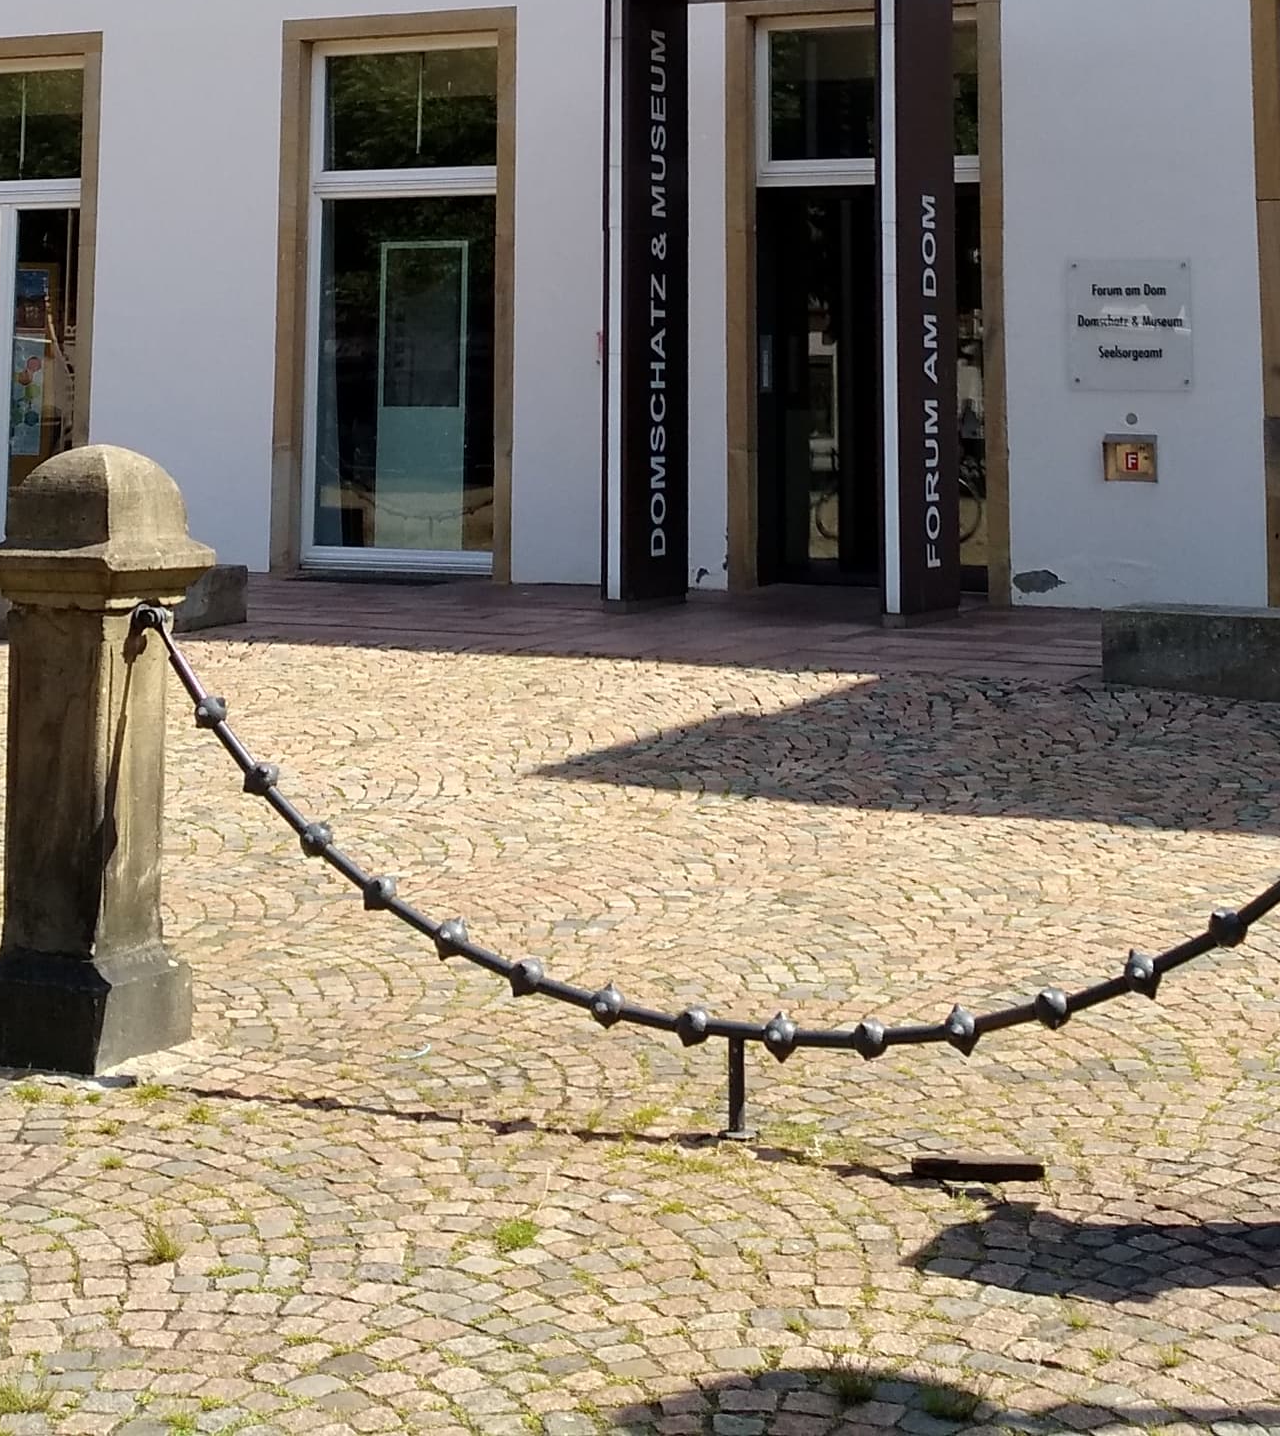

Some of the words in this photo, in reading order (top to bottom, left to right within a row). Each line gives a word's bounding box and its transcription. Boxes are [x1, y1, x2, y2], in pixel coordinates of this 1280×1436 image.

[650, 29, 667, 218] MUSEUM
[651, 231, 667, 261] &
[921, 194, 938, 298] DOM
[1091, 283, 1123, 296] Forum
[1125, 286, 1141, 296] am
[1143, 283, 1167, 296] Dom
[1077, 314, 1129, 327] Domschatz
[1131, 315, 1139, 327] &
[1142, 315, 1183, 328] Museum
[923, 314, 939, 384] AM
[1098, 345, 1163, 361] Seelsorgeamt
[650, 273, 667, 557] DOMSCHATZ
[925, 398, 942, 569] FORUM
[1127, 454, 1137, 469] F
